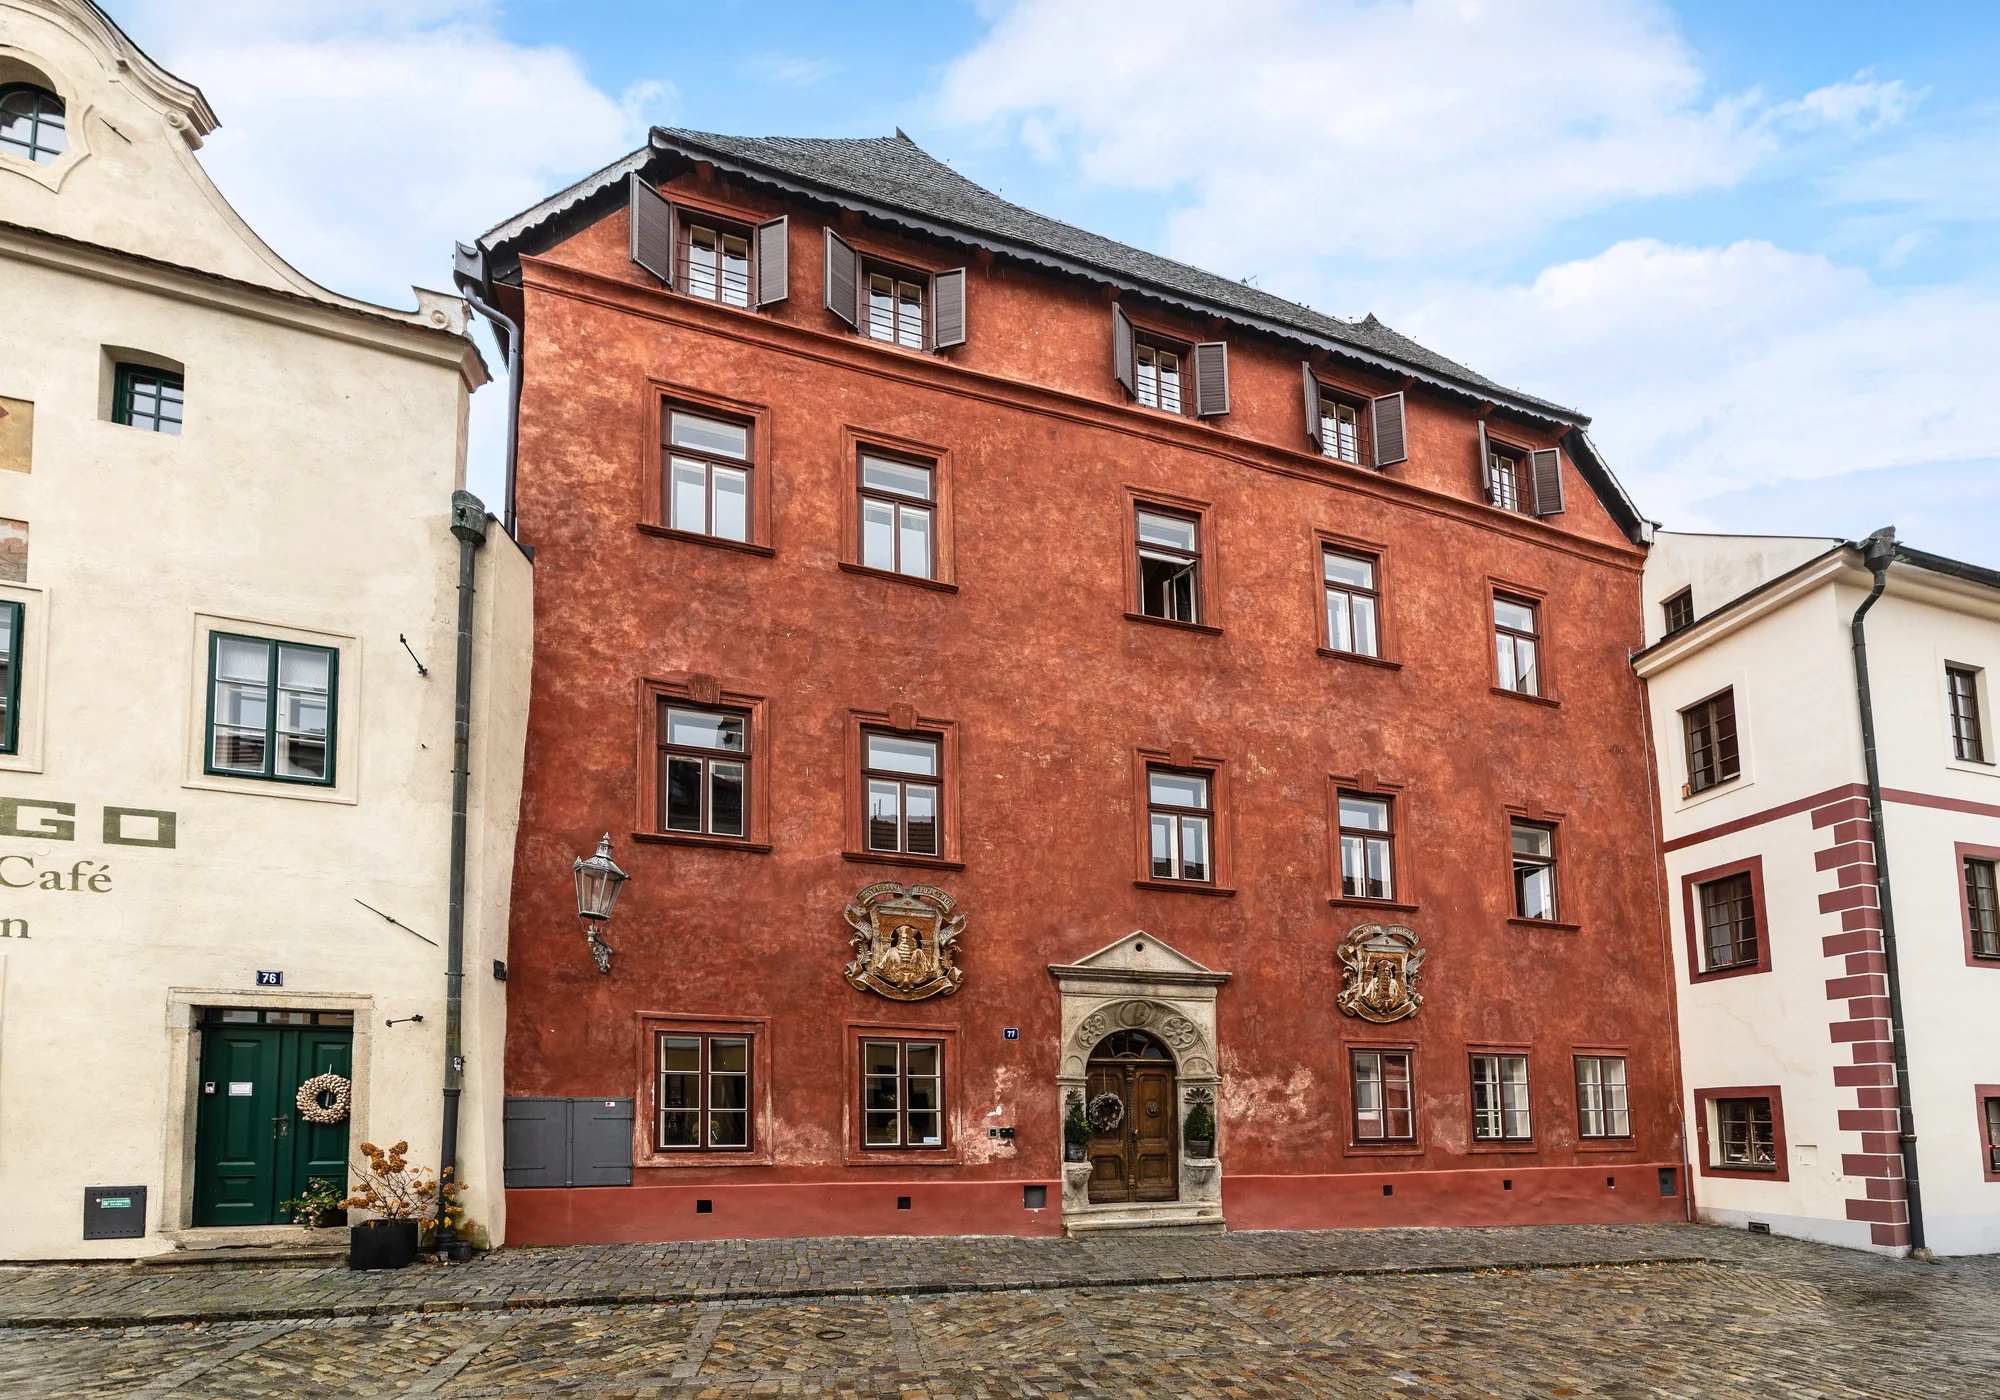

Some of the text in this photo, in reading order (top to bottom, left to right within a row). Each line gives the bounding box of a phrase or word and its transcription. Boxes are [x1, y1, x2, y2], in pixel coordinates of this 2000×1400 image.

[0, 855, 113, 893] Café
[262, 973, 276, 983] 76
[1007, 1030, 1015, 1038] 77
